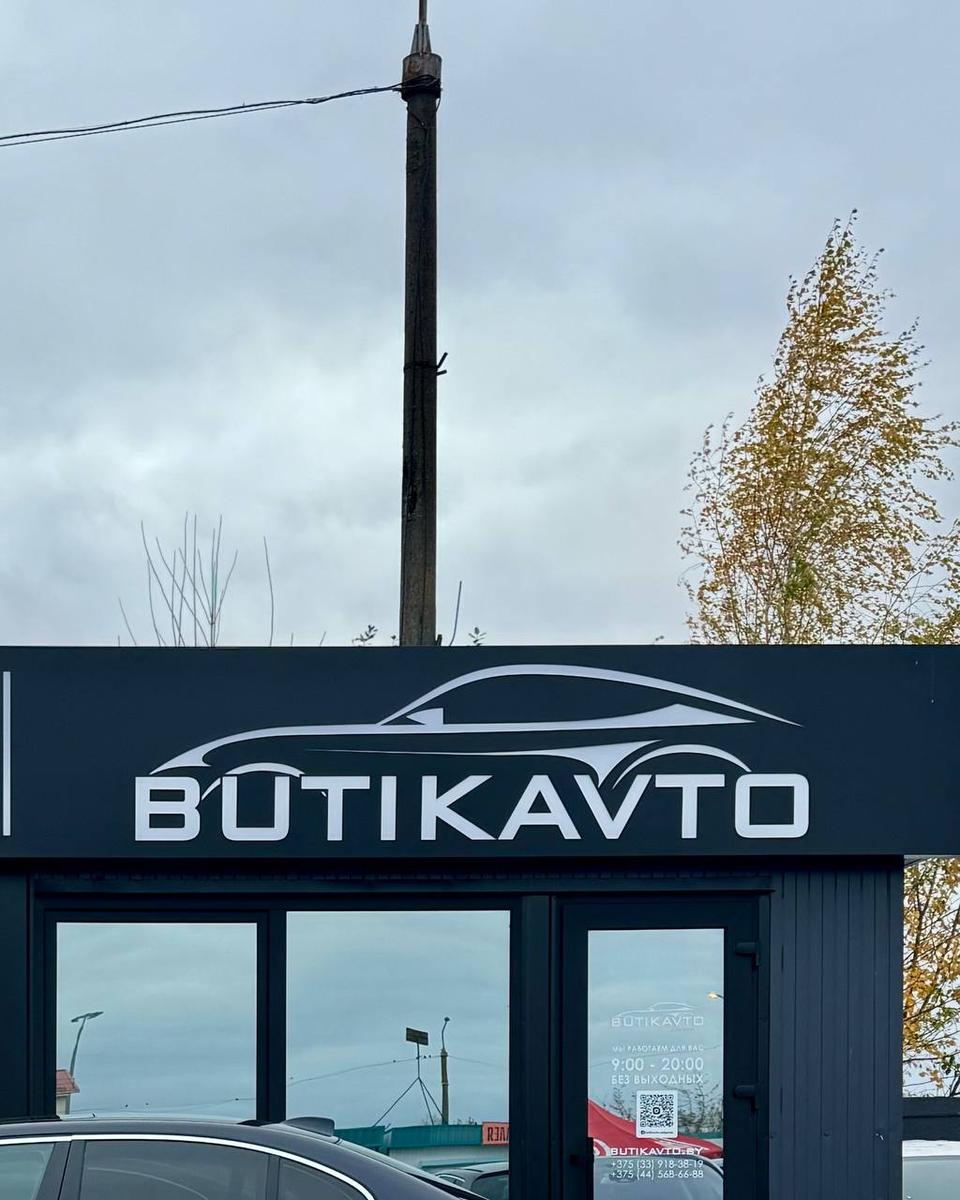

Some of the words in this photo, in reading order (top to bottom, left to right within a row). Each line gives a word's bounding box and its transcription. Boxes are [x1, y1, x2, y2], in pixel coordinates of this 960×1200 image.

[134, 772, 810, 842] BUTIKAVTO
[611, 1016, 704, 1027] BUTIKAVTO
[611, 1057, 644, 1072] 9:00
[661, 1057, 704, 1071] 20:00
[611, 1074, 630, 1085] БЕЗ
[633, 1074, 704, 1085] ВЫХОДНЫХ
[610, 1147, 704, 1156] BUTIKAVTO.BY
[611, 1160, 634, 1169] +375
[637, 1159, 654, 1170] (33)
[657, 1160, 704, 1169] 918-38-19
[611, 1170, 634, 1179] +375
[637, 1169, 654, 1181] (44)
[657, 1170, 704, 1179] 568-66-88
